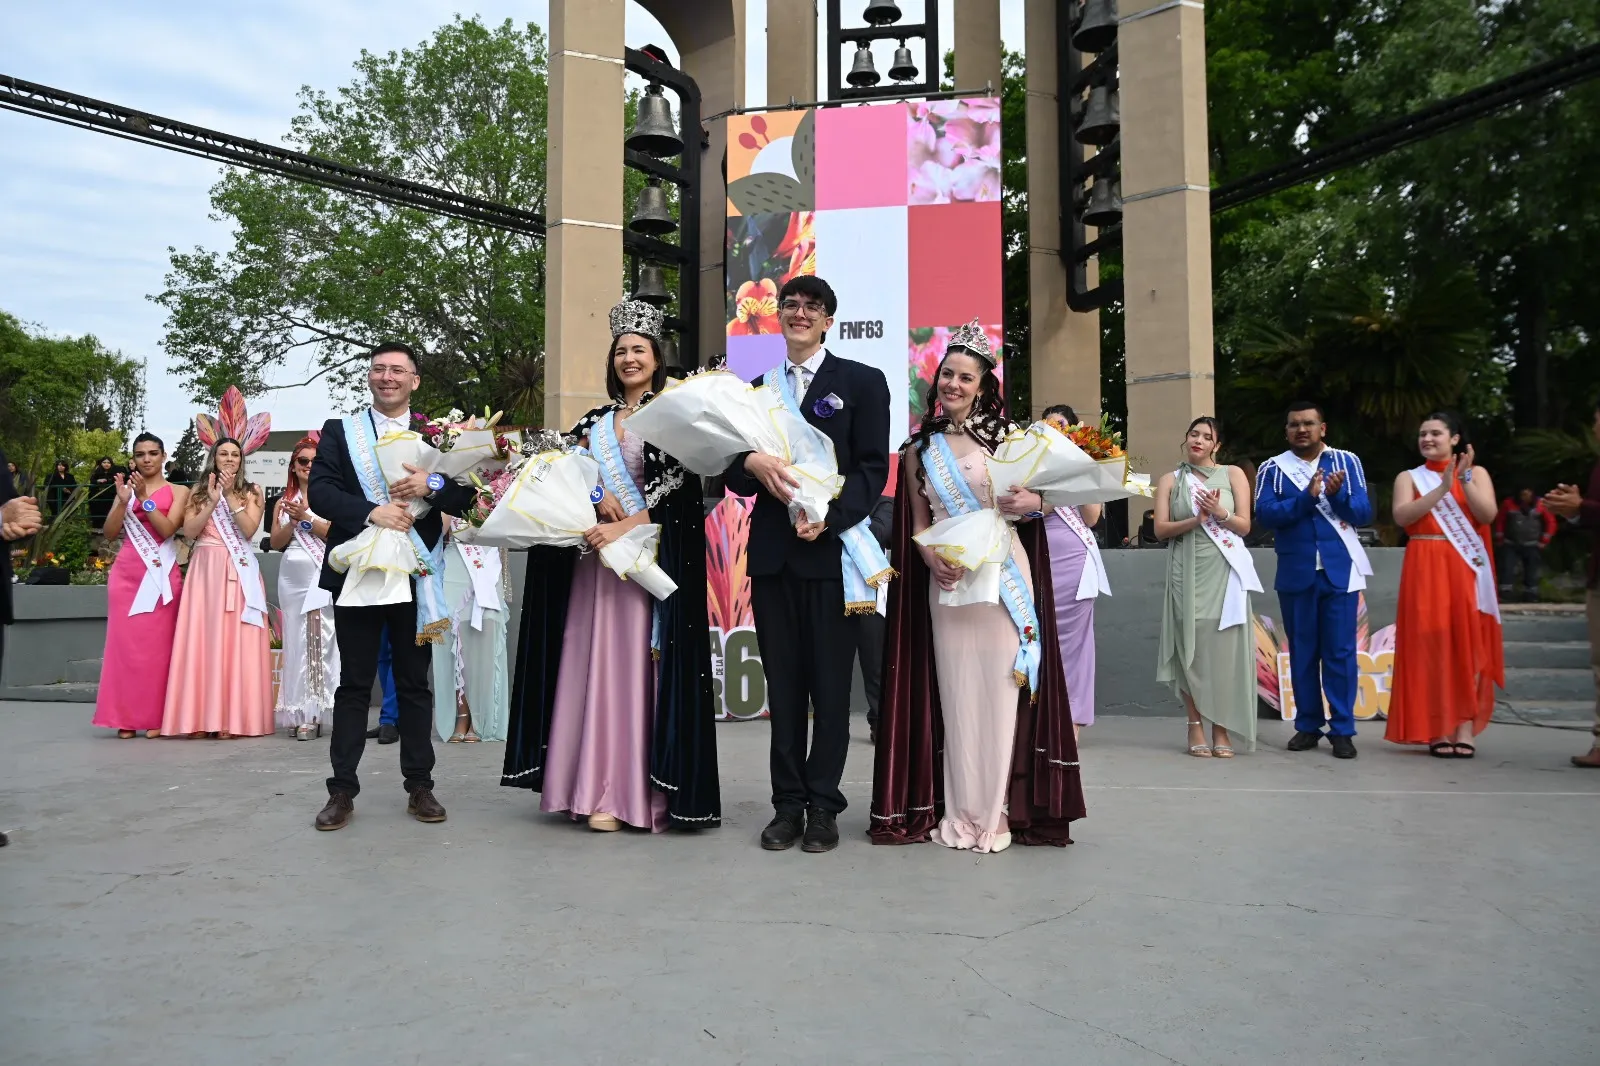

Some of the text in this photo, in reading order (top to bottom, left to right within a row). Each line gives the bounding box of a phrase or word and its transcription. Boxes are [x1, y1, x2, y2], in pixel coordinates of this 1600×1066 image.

[839, 319, 884, 340] FNF63
[363, 459, 388, 506] NACIONAL
[429, 475, 440, 488] 10
[608, 466, 636, 513] NACIONAL
[716, 659, 723, 667] LA
[725, 630, 765, 717] 6
